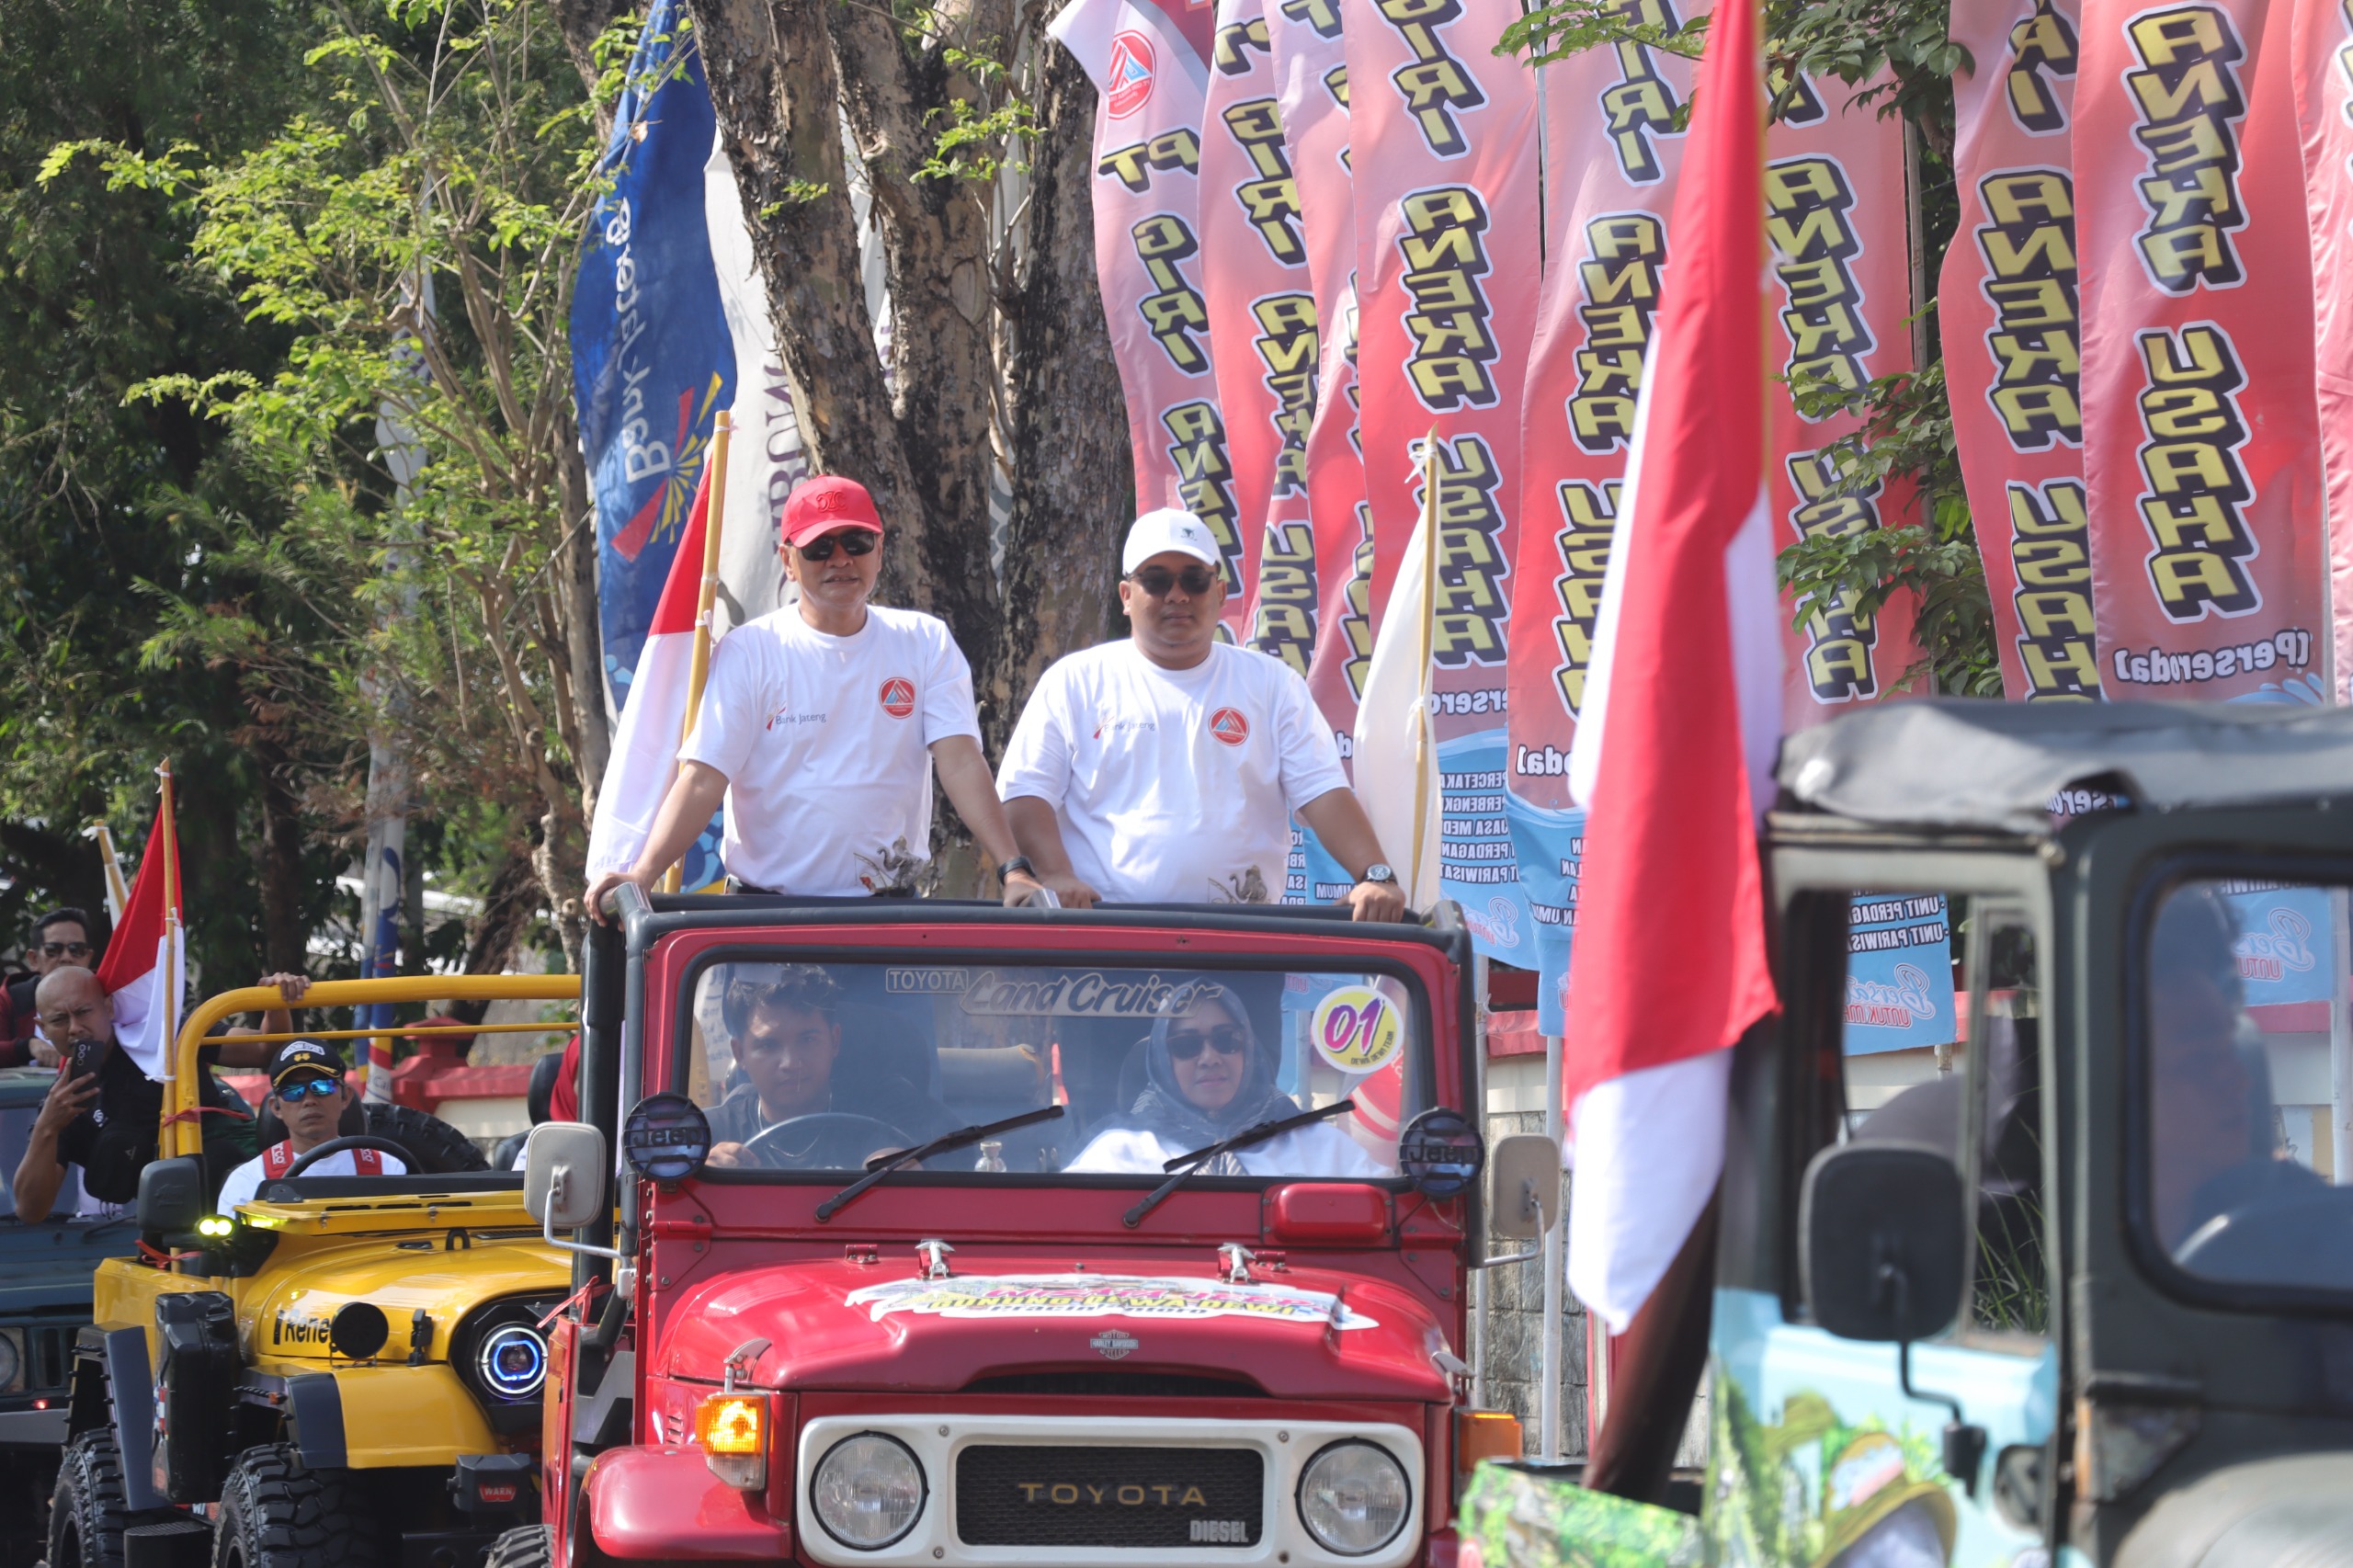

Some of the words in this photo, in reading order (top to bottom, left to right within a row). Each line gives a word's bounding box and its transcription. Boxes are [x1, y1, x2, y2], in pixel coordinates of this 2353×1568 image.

[776, 714, 796, 724] Bank
[799, 712, 826, 724] Jateng
[889, 971, 965, 991] TOYOTA
[961, 971, 1069, 1014] Land
[1067, 972, 1223, 1015] Cruiser
[1324, 997, 1385, 1056] 01
[1382, 1031, 1393, 1049] TEAM
[927, 1296, 1073, 1309] GUNUNG
[1081, 1295, 1188, 1308] DEWA
[1197, 1301, 1302, 1316] DEWI
[1179, 1291, 1313, 1307] JEEP
[484, 1486, 513, 1495] WARN
[1017, 1483, 1208, 1506] TOYOTA
[1189, 1520, 1249, 1542] DIESEL
